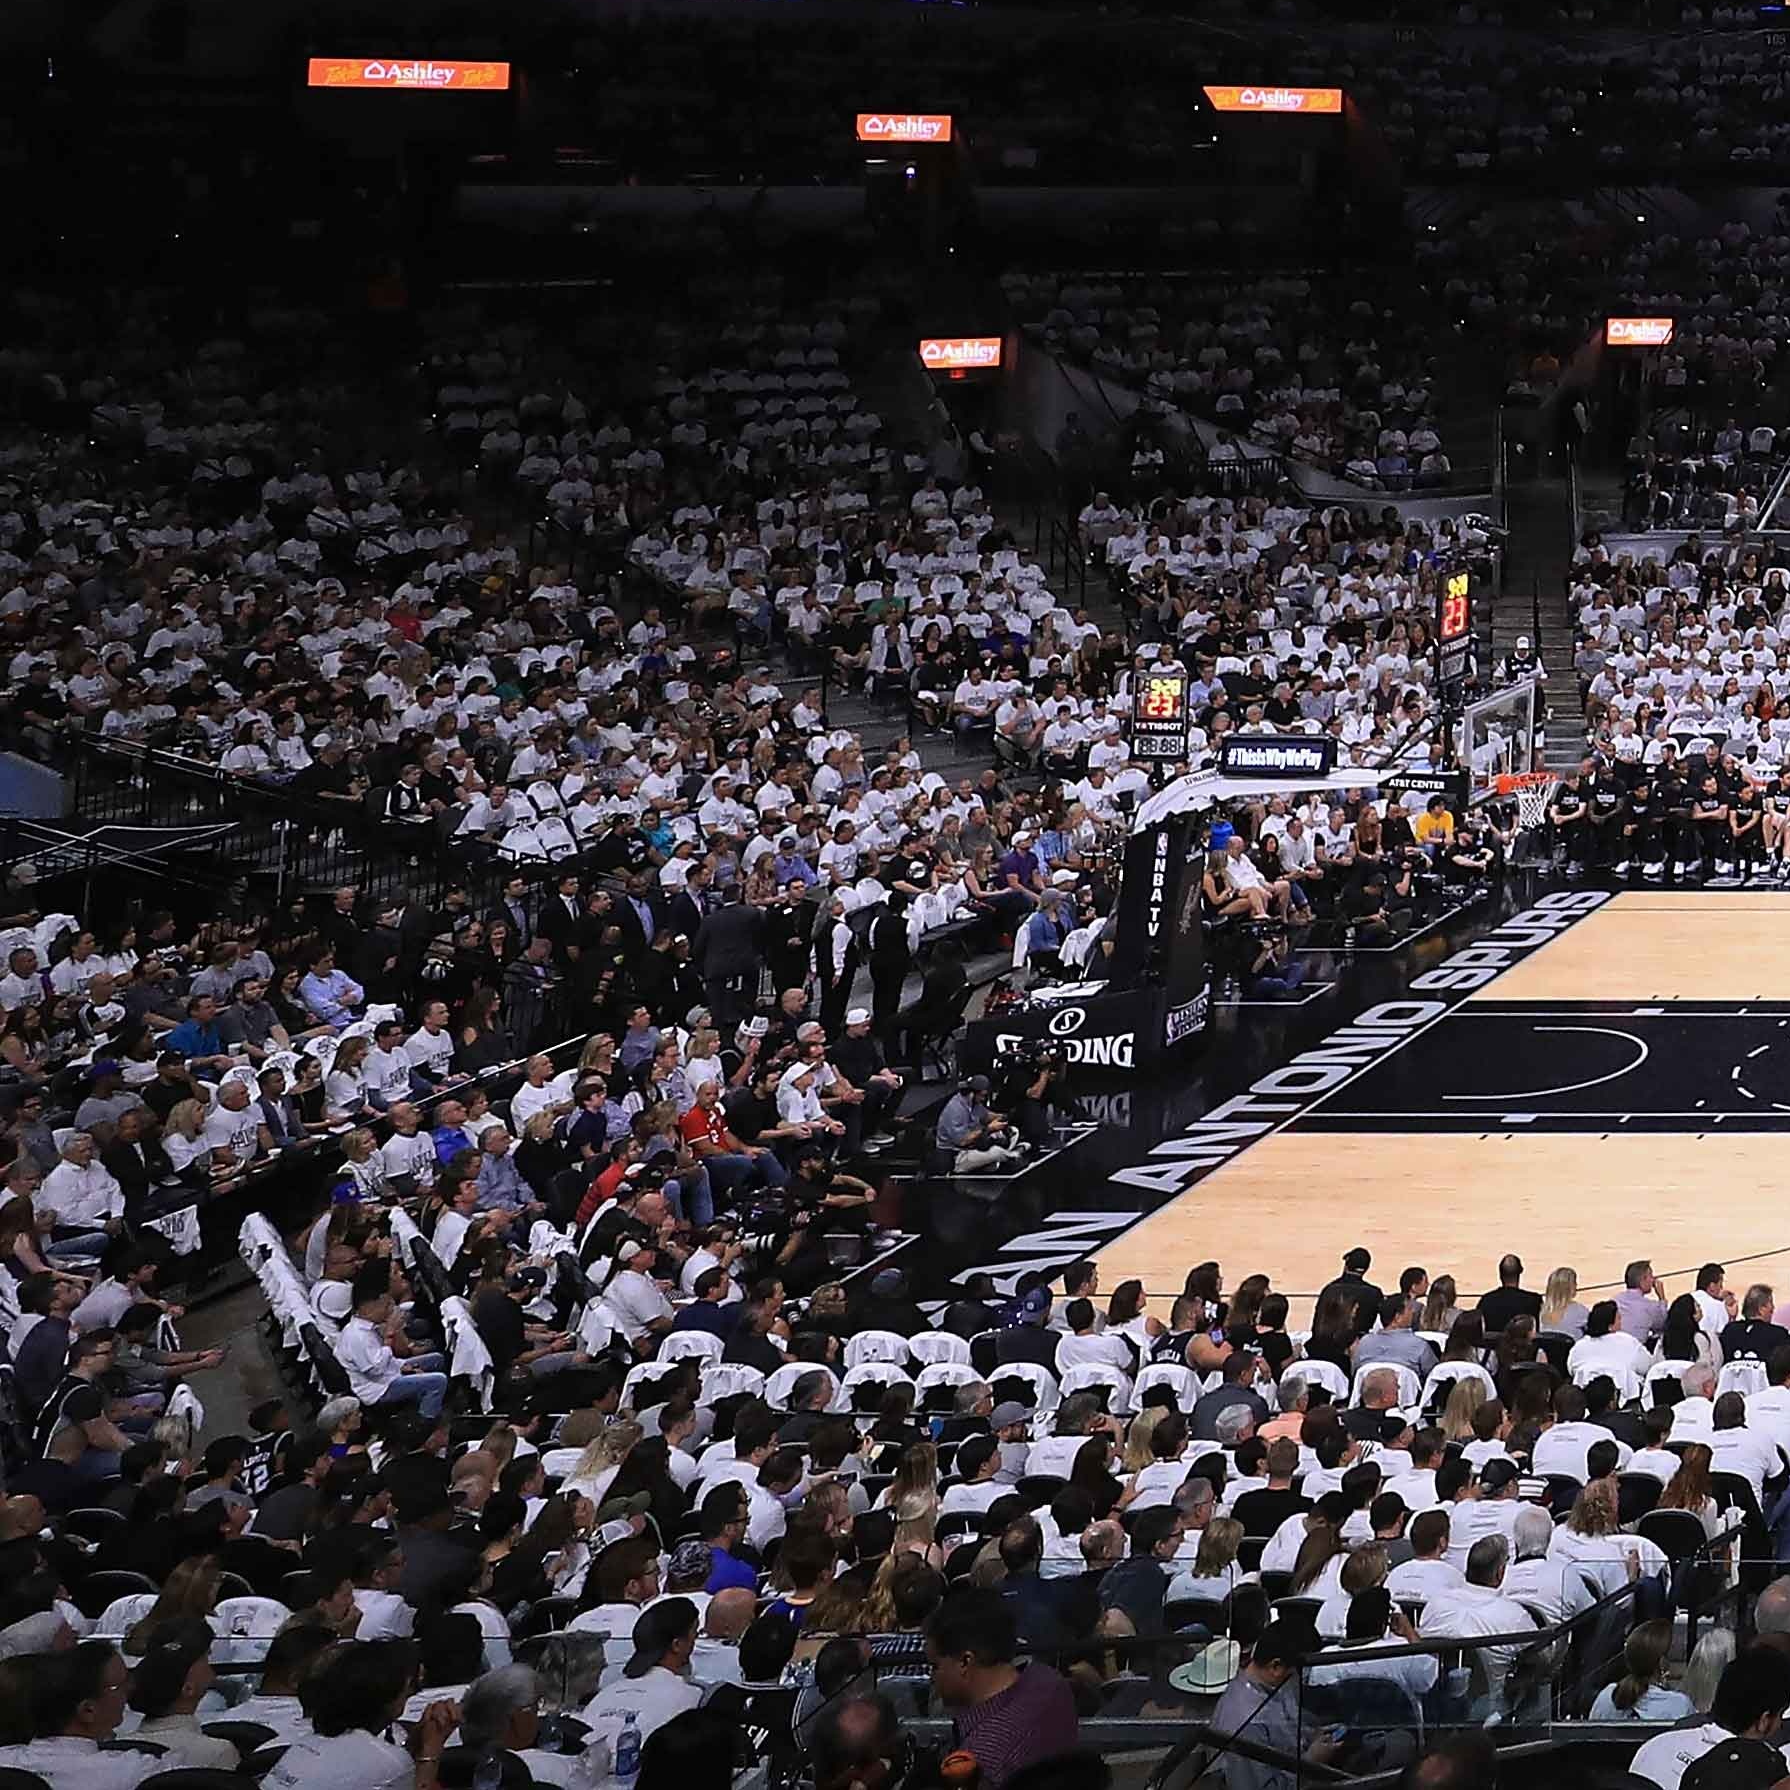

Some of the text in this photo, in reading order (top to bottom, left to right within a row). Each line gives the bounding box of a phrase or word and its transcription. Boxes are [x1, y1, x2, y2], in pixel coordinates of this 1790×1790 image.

[387, 61, 455, 86] Ashley
[1256, 89, 1305, 107] Ashley
[884, 116, 942, 136] Ashley
[943, 341, 998, 360] Ashley
[1147, 695, 1174, 717] 23
[1388, 778, 1446, 790] AT&T CENTER
[1147, 858, 1167, 937] NBA TV
[1107, 890, 1612, 1195] ANTONIO SPURS
